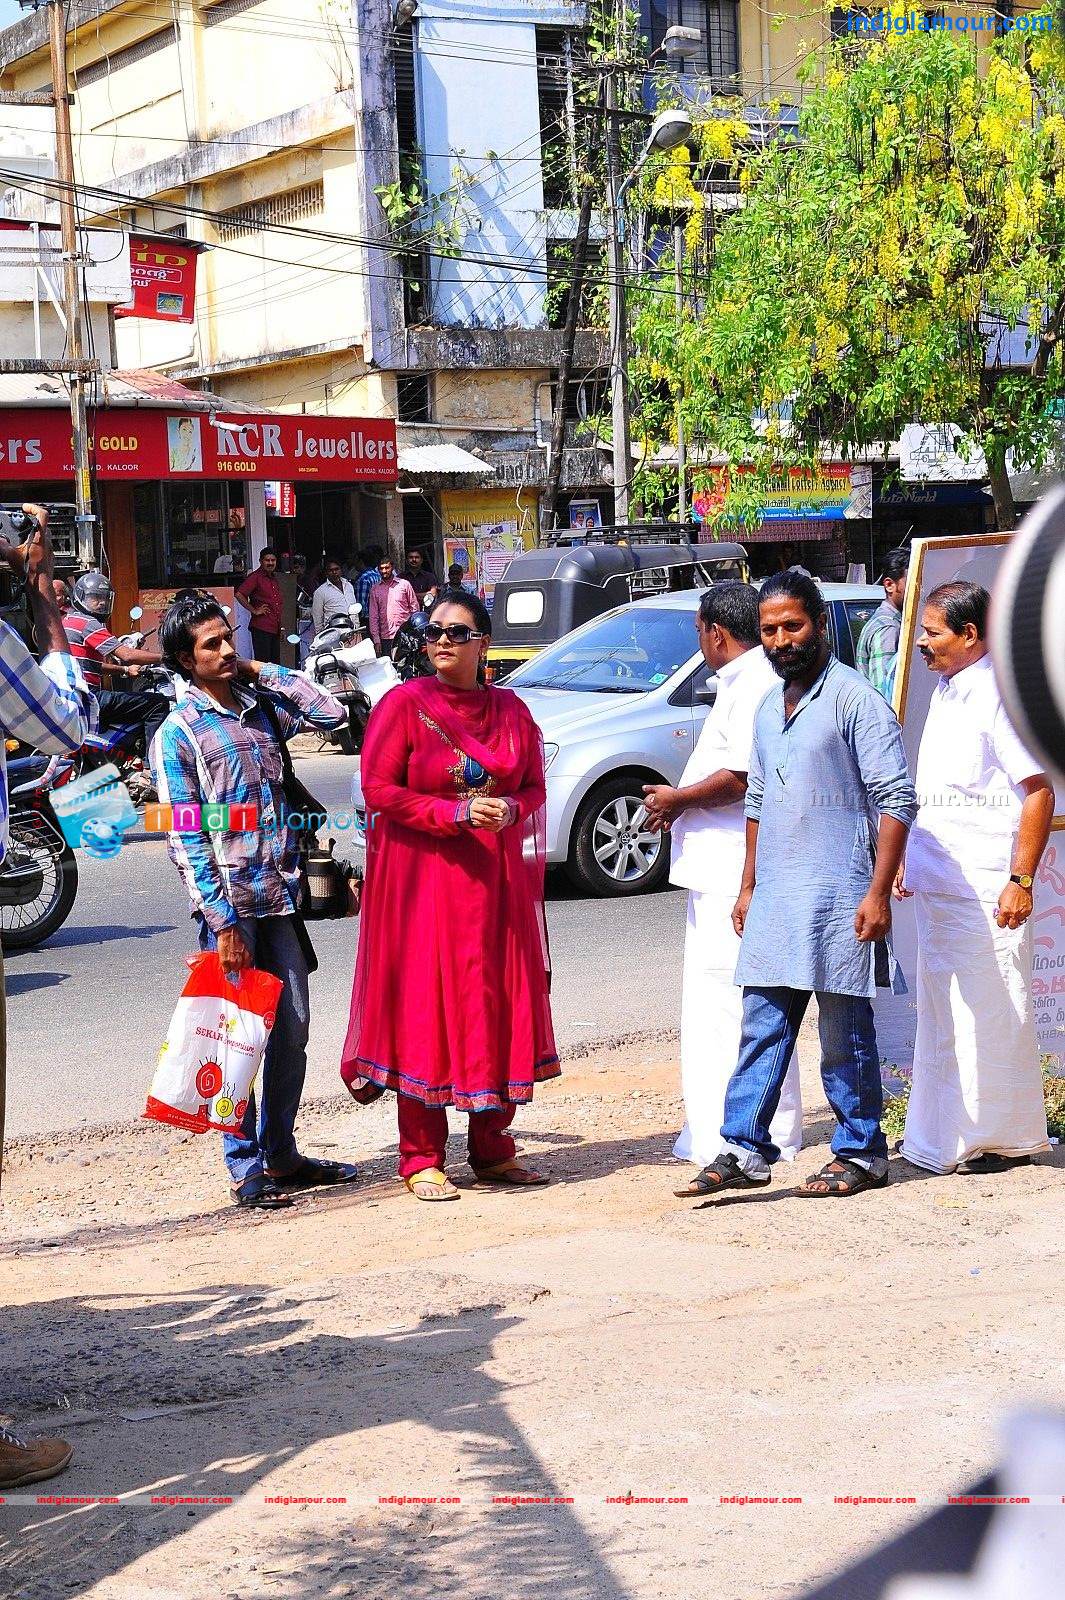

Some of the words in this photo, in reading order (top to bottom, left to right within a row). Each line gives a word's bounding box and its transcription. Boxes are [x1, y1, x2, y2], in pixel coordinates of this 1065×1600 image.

[99, 436, 138, 451] GOLD
[294, 429, 395, 460] Jewellers
[217, 461, 232, 472] 916
[233, 462, 257, 472] GOLD
[195, 1026, 223, 1042] SEKAR
